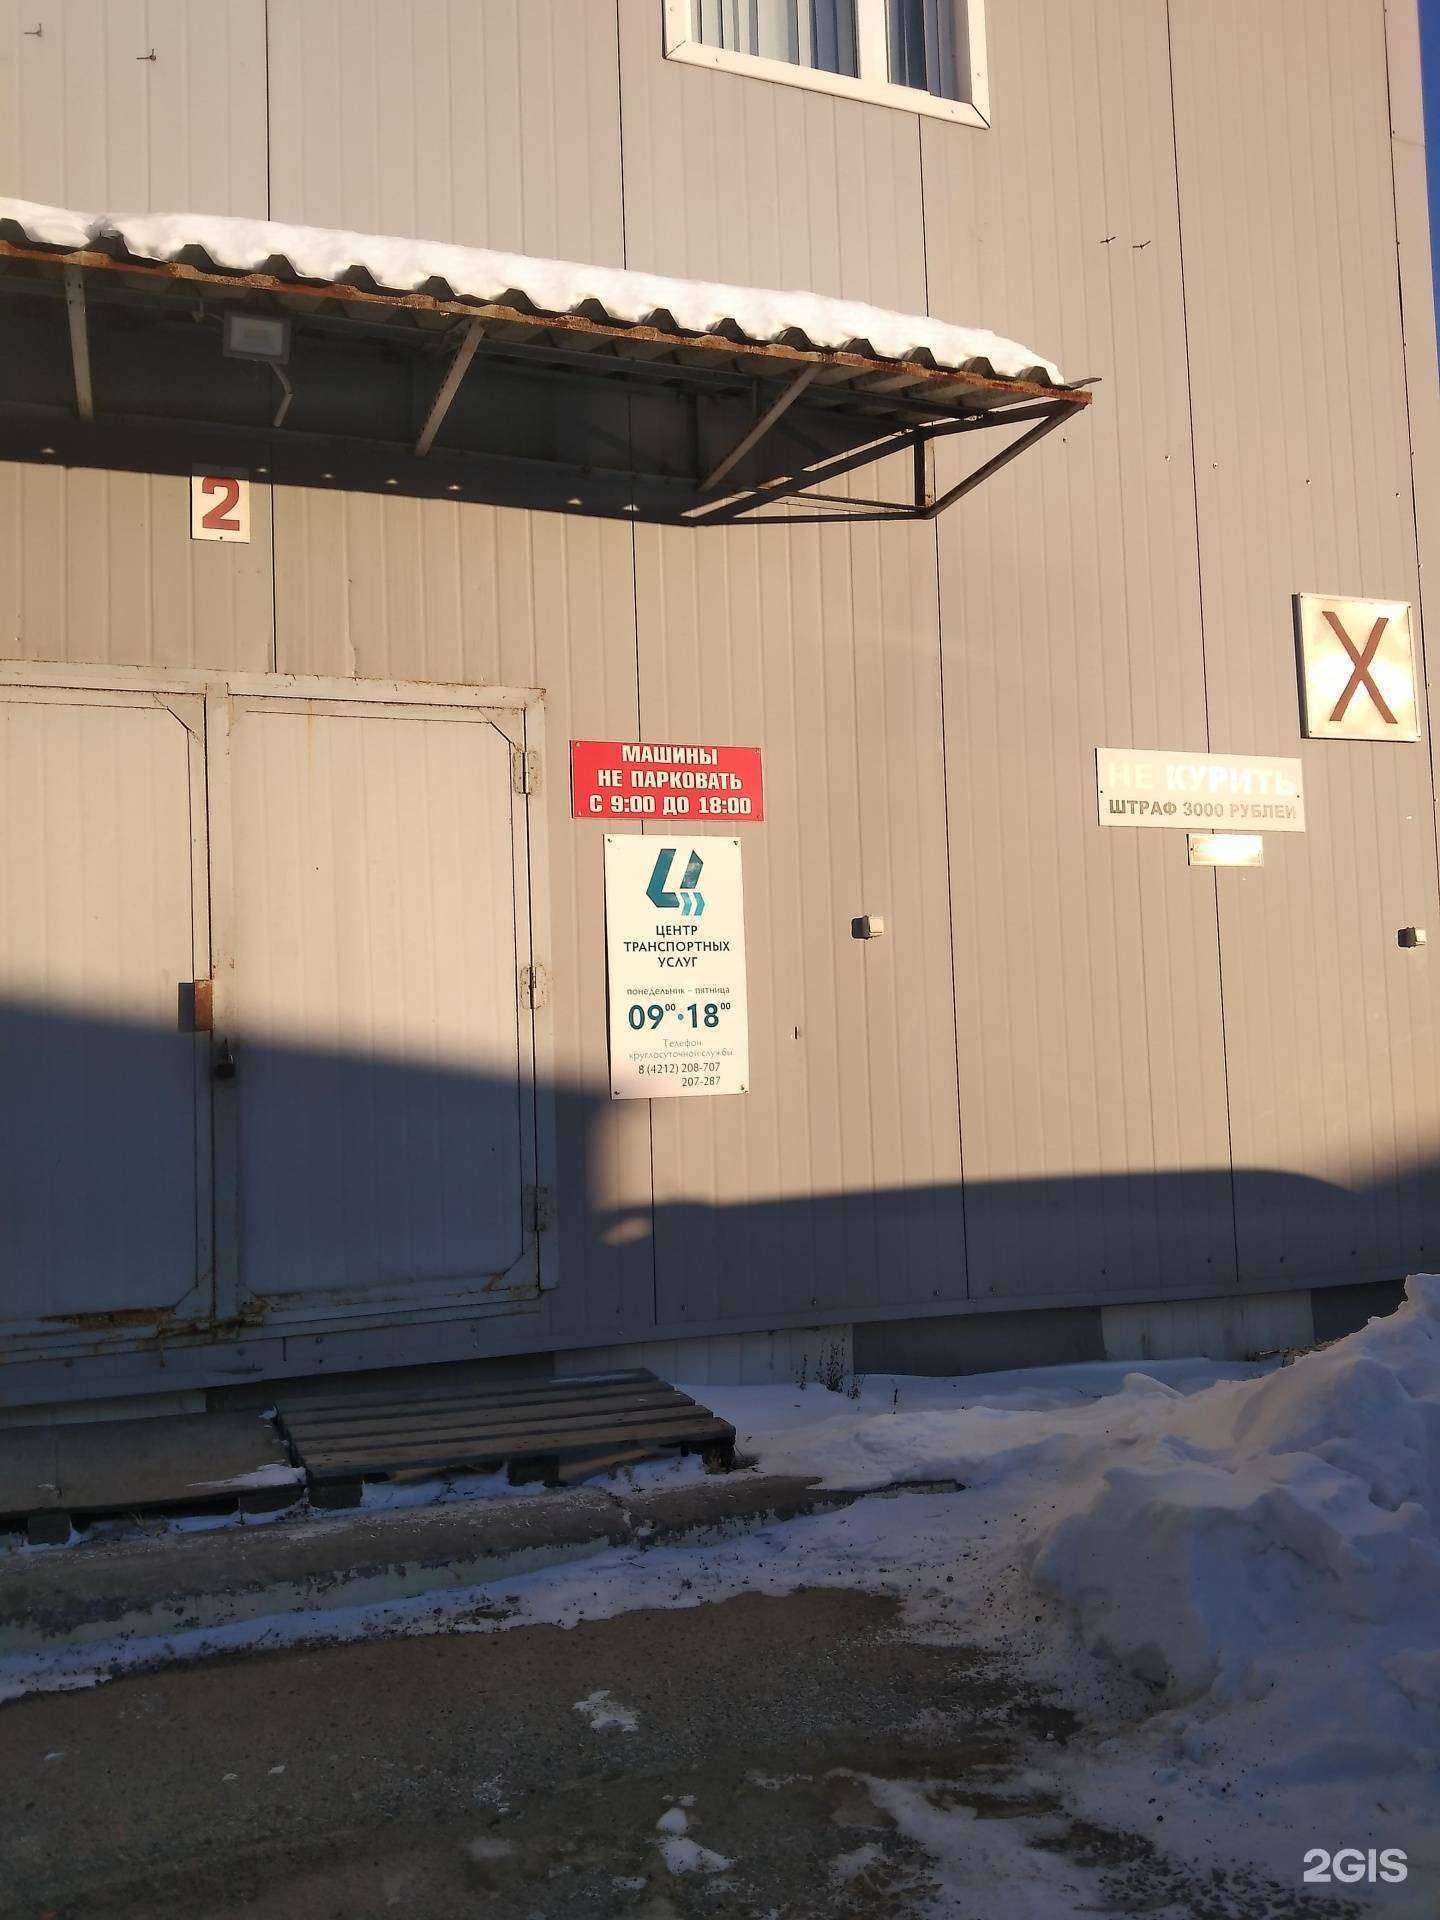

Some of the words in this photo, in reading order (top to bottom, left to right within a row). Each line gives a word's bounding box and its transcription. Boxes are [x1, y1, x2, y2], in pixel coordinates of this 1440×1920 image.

[202, 475, 240, 531] 2
[621, 745, 718, 765] МАШИНЫ
[597, 769, 623, 787] НЕ
[630, 770, 742, 790] ПАРКОВАТЬ
[1108, 762, 1153, 790] НЕ
[1165, 763, 1297, 796] КУРИТЬ
[589, 795, 603, 812] С
[610, 795, 656, 813] 9:00
[662, 796, 690, 816] ДО
[698, 796, 752, 815] 18:00
[1108, 799, 1178, 816] ШТРАФ
[1182, 801, 1225, 818] 3000
[656, 925, 698, 938] ЦЕНТР
[623, 941, 730, 952] ТРАНСПОРТНЫХ
[657, 957, 698, 968] УСЛУГ
[626, 988, 685, 996] понедельник
[694, 987, 730, 995] пятница
[662, 1039, 702, 1049] Телефон
[638, 1065, 645, 1075] 8
[647, 1063, 679, 1076] (4212)
[681, 1062, 721, 1073] 208-707
[682, 1077, 721, 1087] 207-287
